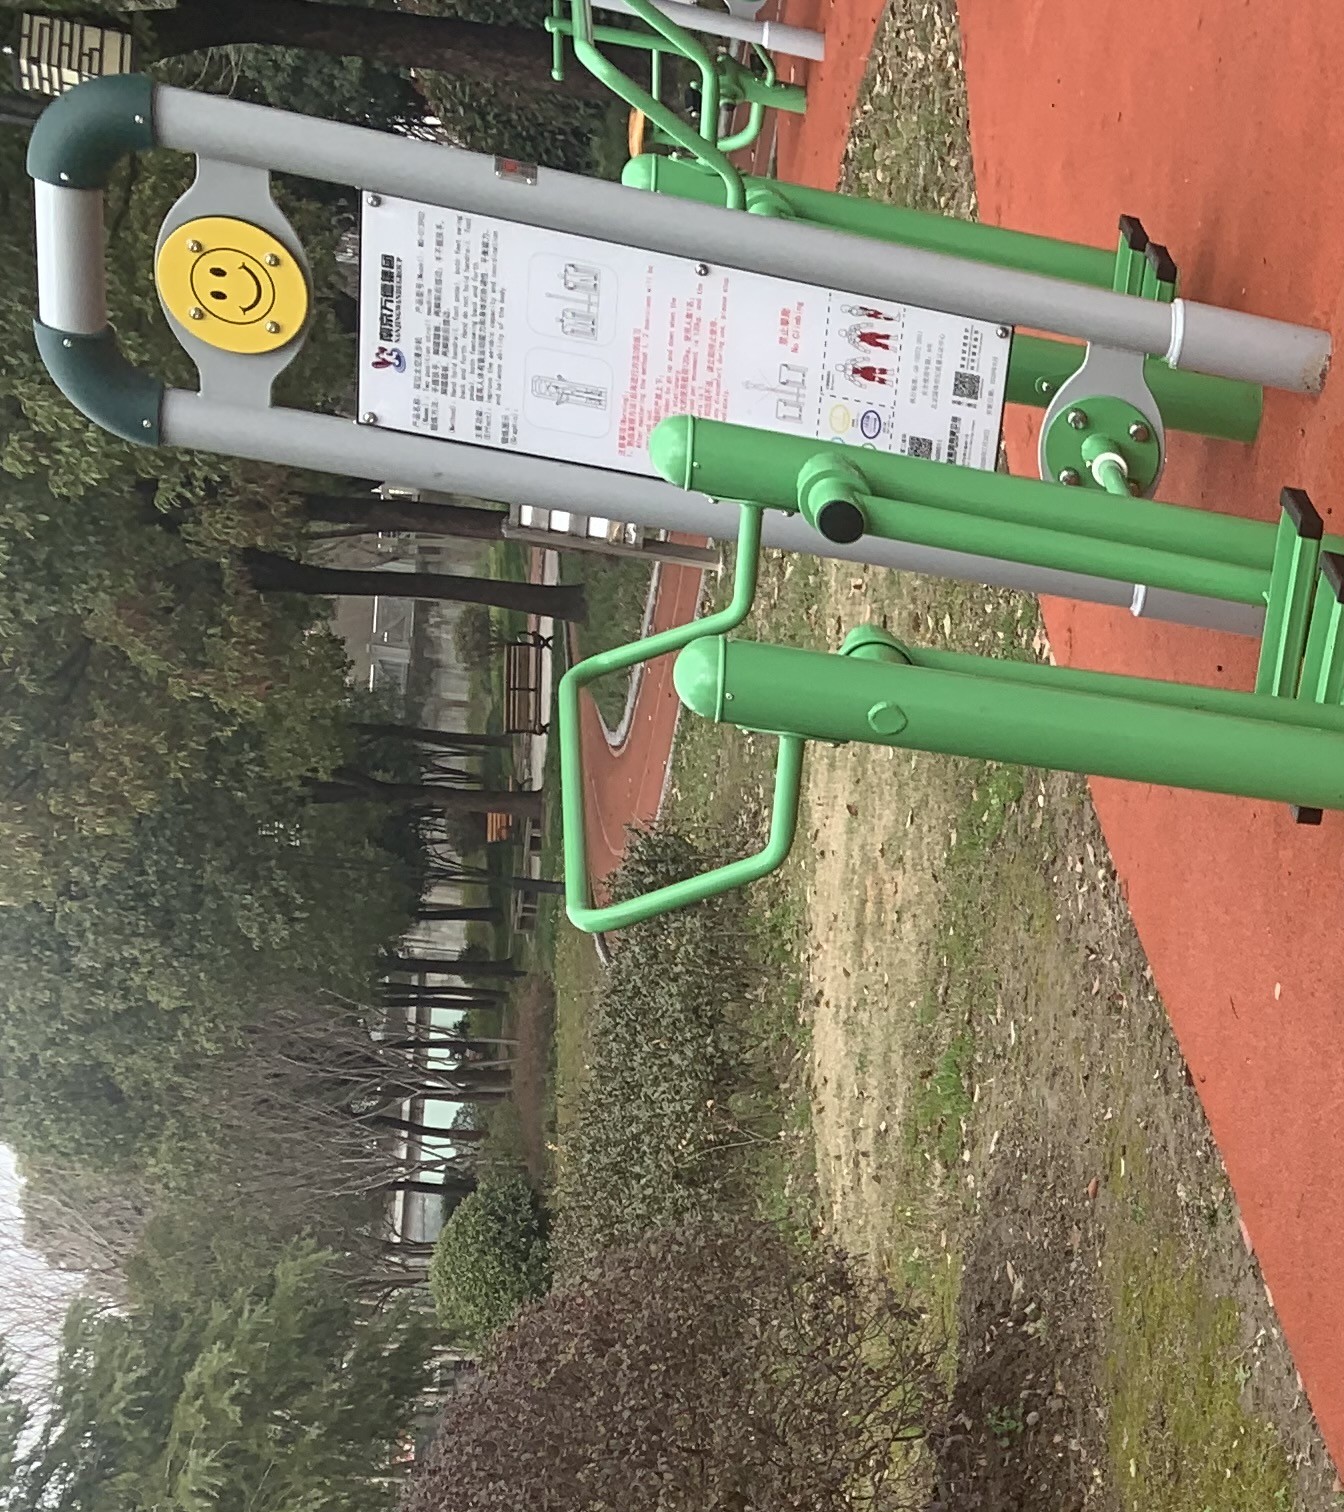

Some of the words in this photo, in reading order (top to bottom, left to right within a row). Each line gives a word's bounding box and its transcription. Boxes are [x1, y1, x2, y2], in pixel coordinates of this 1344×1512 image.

[379, 254, 395, 342] 南京万德集团
